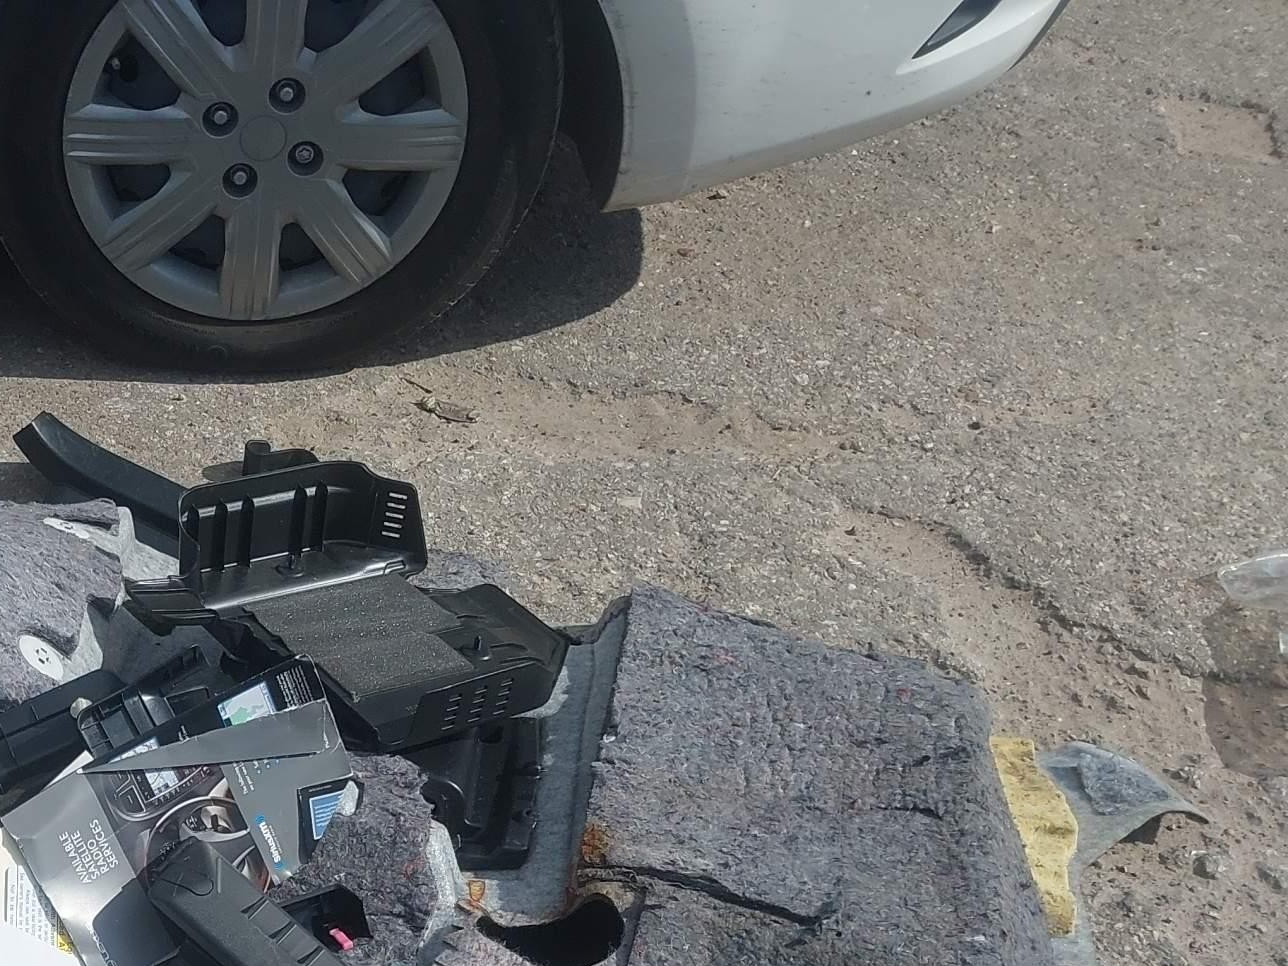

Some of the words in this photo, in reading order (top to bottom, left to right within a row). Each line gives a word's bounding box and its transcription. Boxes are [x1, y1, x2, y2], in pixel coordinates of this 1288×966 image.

[59, 831, 92, 883] AVAILABLE
[70, 830, 100, 879] SATELLITE
[87, 839, 109, 874] RADIO
[89, 819, 118, 868] SERVICES
